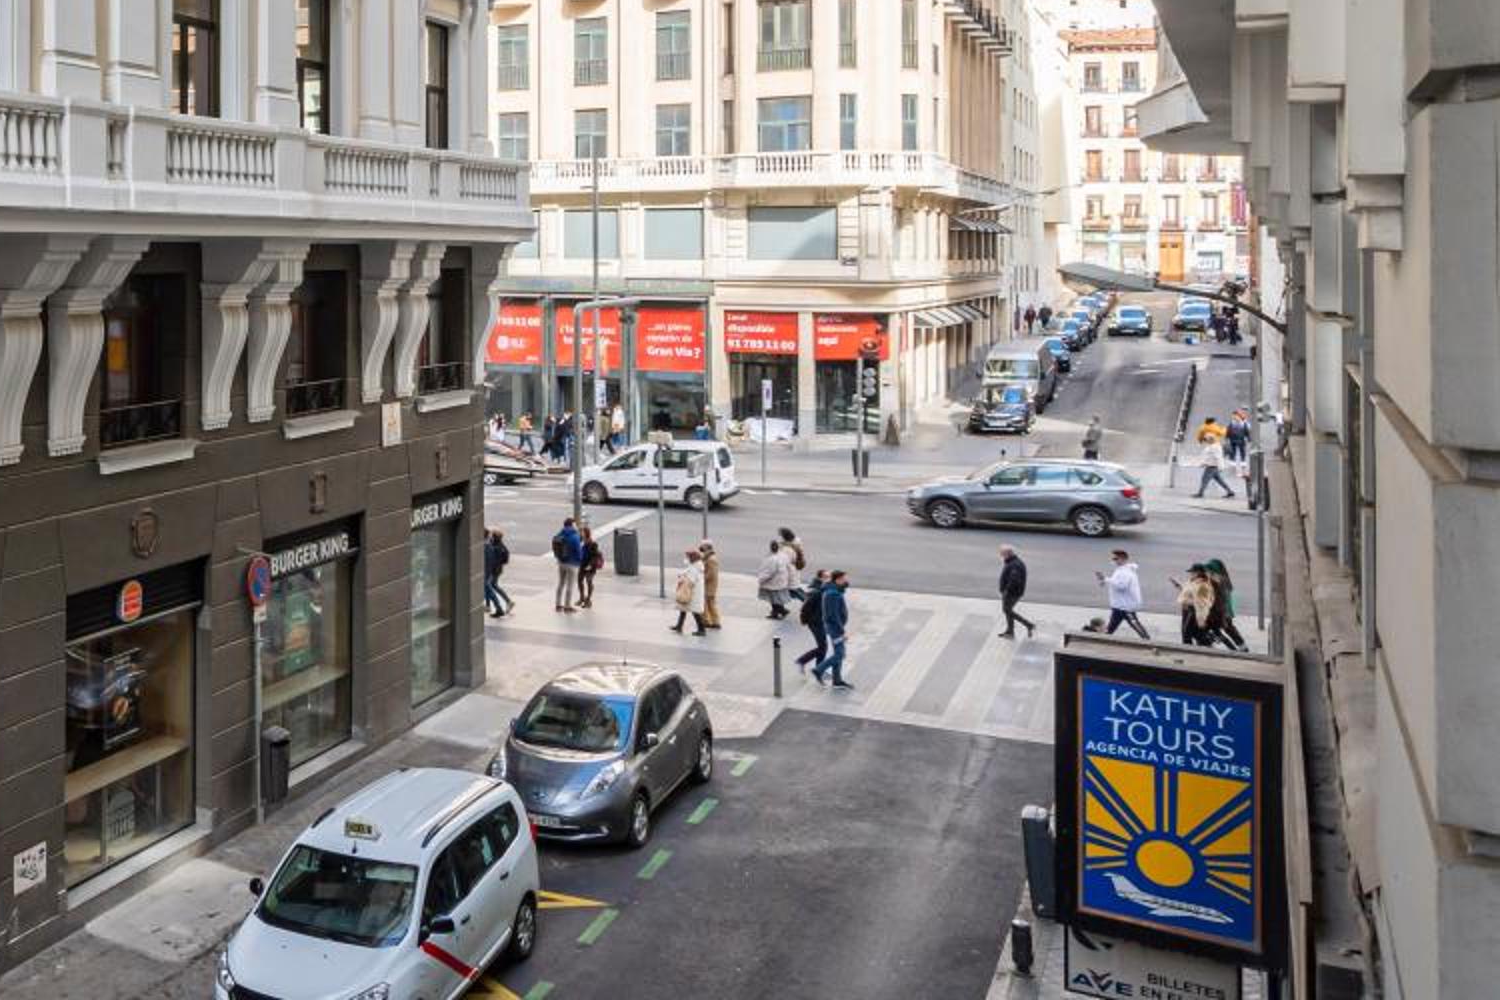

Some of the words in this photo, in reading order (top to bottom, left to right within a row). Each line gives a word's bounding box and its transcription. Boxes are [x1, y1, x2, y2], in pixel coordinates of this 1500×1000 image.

[440, 495, 464, 518] KING
[270, 542, 319, 577] BURGER
[319, 532, 350, 558] KING
[1109, 688, 1233, 730] KATHY
[1103, 716, 1236, 760] TOURS
[1085, 740, 1159, 763] AGENCIA
[1163, 753, 1186, 767] DE
[1190, 756, 1252, 778] VIAJES
[1072, 967, 1134, 997] AVE
[1146, 972, 1226, 1000] BILLETES
